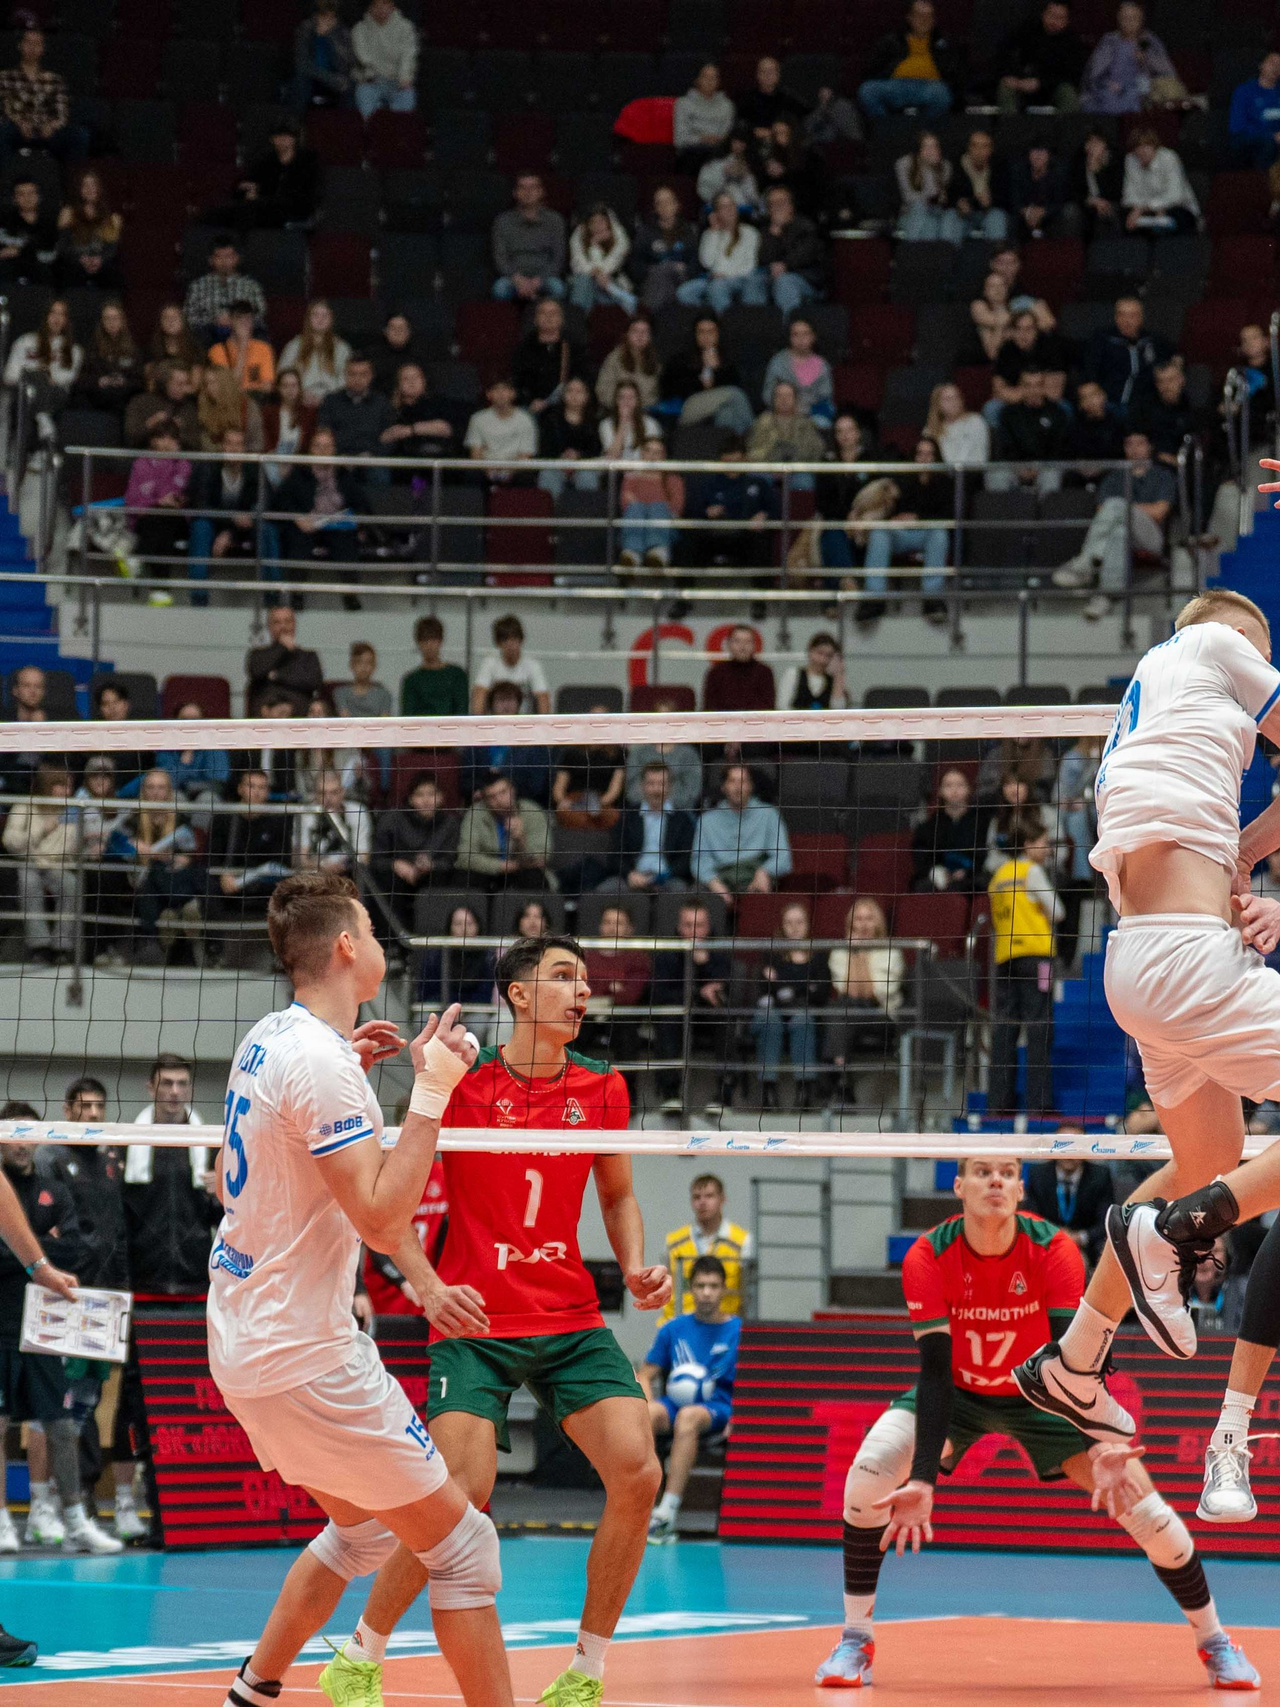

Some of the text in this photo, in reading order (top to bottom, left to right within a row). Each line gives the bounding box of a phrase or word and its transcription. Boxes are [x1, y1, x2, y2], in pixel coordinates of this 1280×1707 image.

[334, 1116, 364, 1135] ВФВ
[224, 1089, 251, 1199] 15
[523, 1168, 544, 1229] 1
[965, 1329, 1018, 1368] 17
[440, 1376, 448, 1399] 1
[405, 1414, 431, 1449] 15
[1176, 1434, 1204, 1465] В
